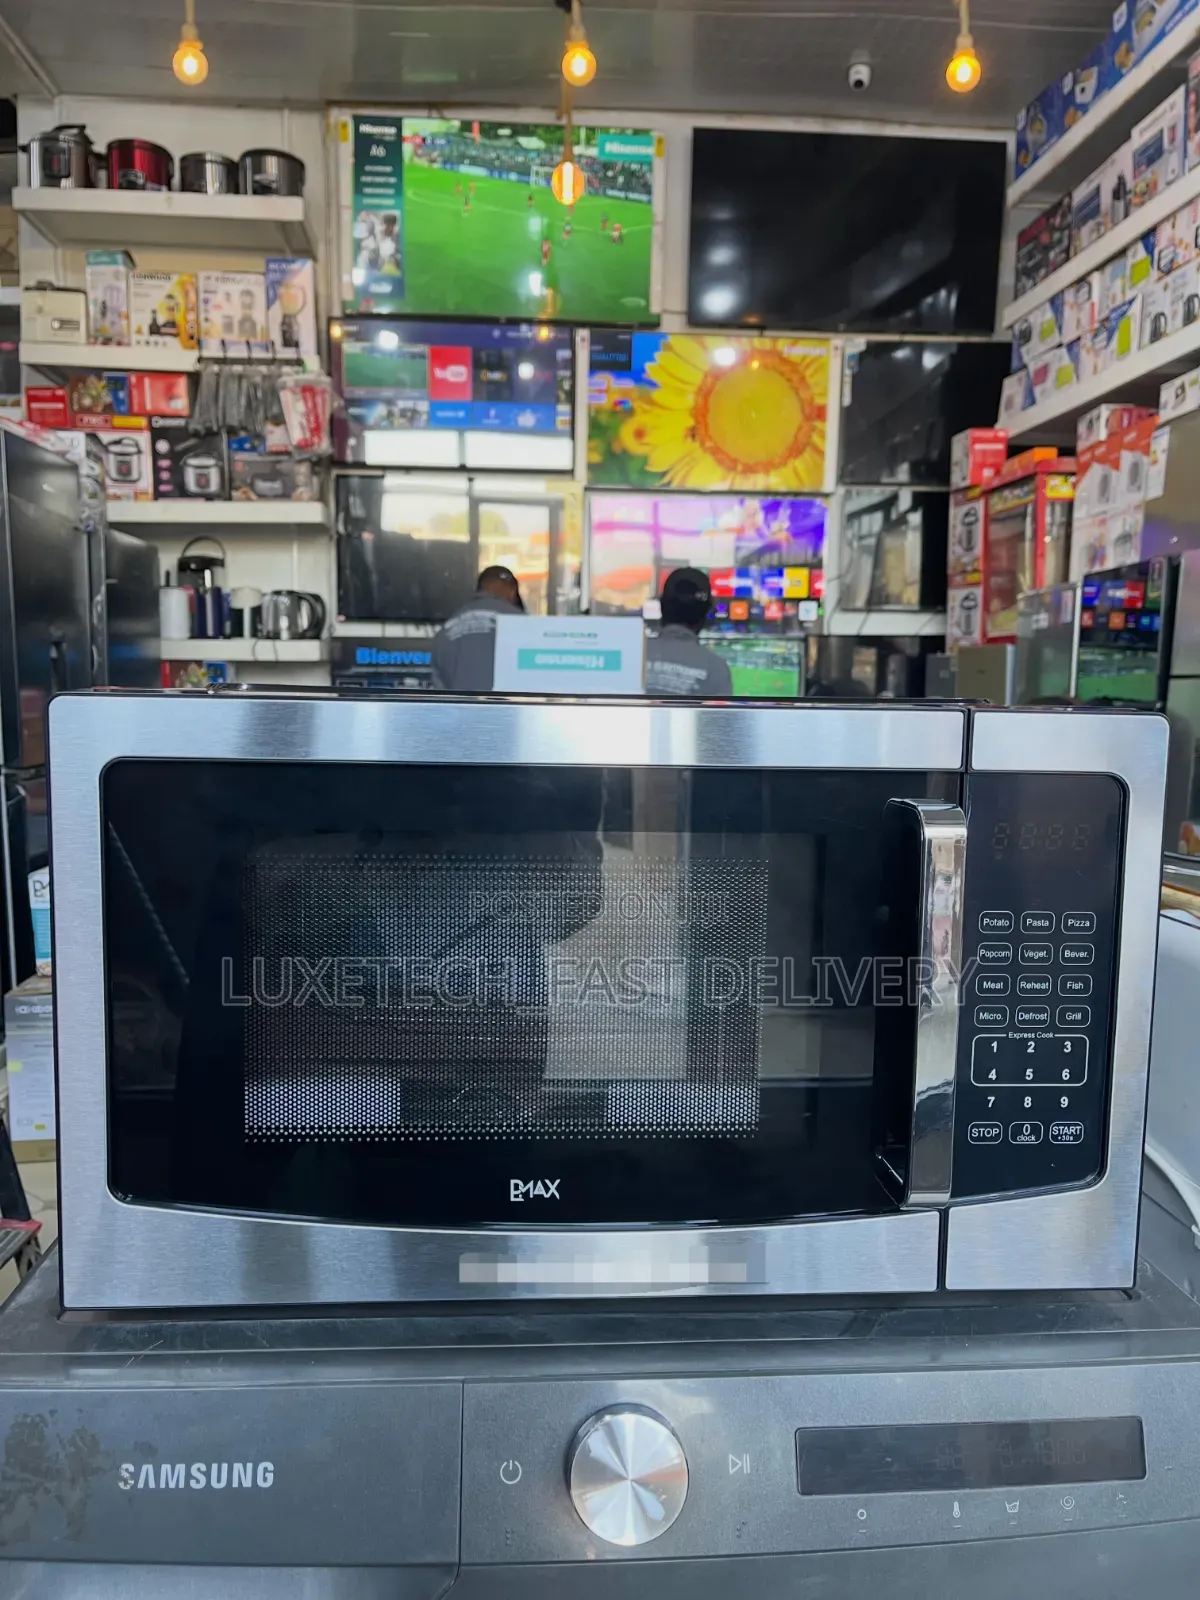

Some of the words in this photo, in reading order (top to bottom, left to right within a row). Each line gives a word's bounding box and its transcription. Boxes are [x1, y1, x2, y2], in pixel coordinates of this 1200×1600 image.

[983, 918, 1010, 927] Potato
[1026, 918, 1049, 927] Pasta
[1068, 918, 1090, 928] Pizza
[979, 949, 1010, 959] Popcorn
[1023, 949, 1048, 959] Veget.
[1064, 950, 1089, 958] Bever.
[983, 981, 1003, 990] Meat
[1020, 981, 1048, 990] Reheat
[1066, 981, 1084, 990] Fish
[979, 1012, 1003, 1020] Micro.
[1018, 1012, 1047, 1020] Defrost
[1065, 1012, 1082, 1021] Grill
[1008, 1031, 1034, 1039] Express
[991, 1042, 998, 1052] 1
[1027, 1042, 1035, 1052] 2
[1063, 1042, 1071, 1053] 3
[988, 1069, 996, 1080] 4
[1025, 1069, 1033, 1080] 5
[1062, 1069, 1070, 1081] 6
[987, 1097, 995, 1108] 7
[1024, 1097, 1032, 1108] 8
[1060, 1097, 1068, 1108] 9
[972, 1127, 999, 1137] STOP
[1022, 1124, 1030, 1135] 0
[1052, 1125, 1081, 1135] START
[1017, 1134, 1036, 1142] clock
[117, 1461, 275, 1490] SAMSUNG
